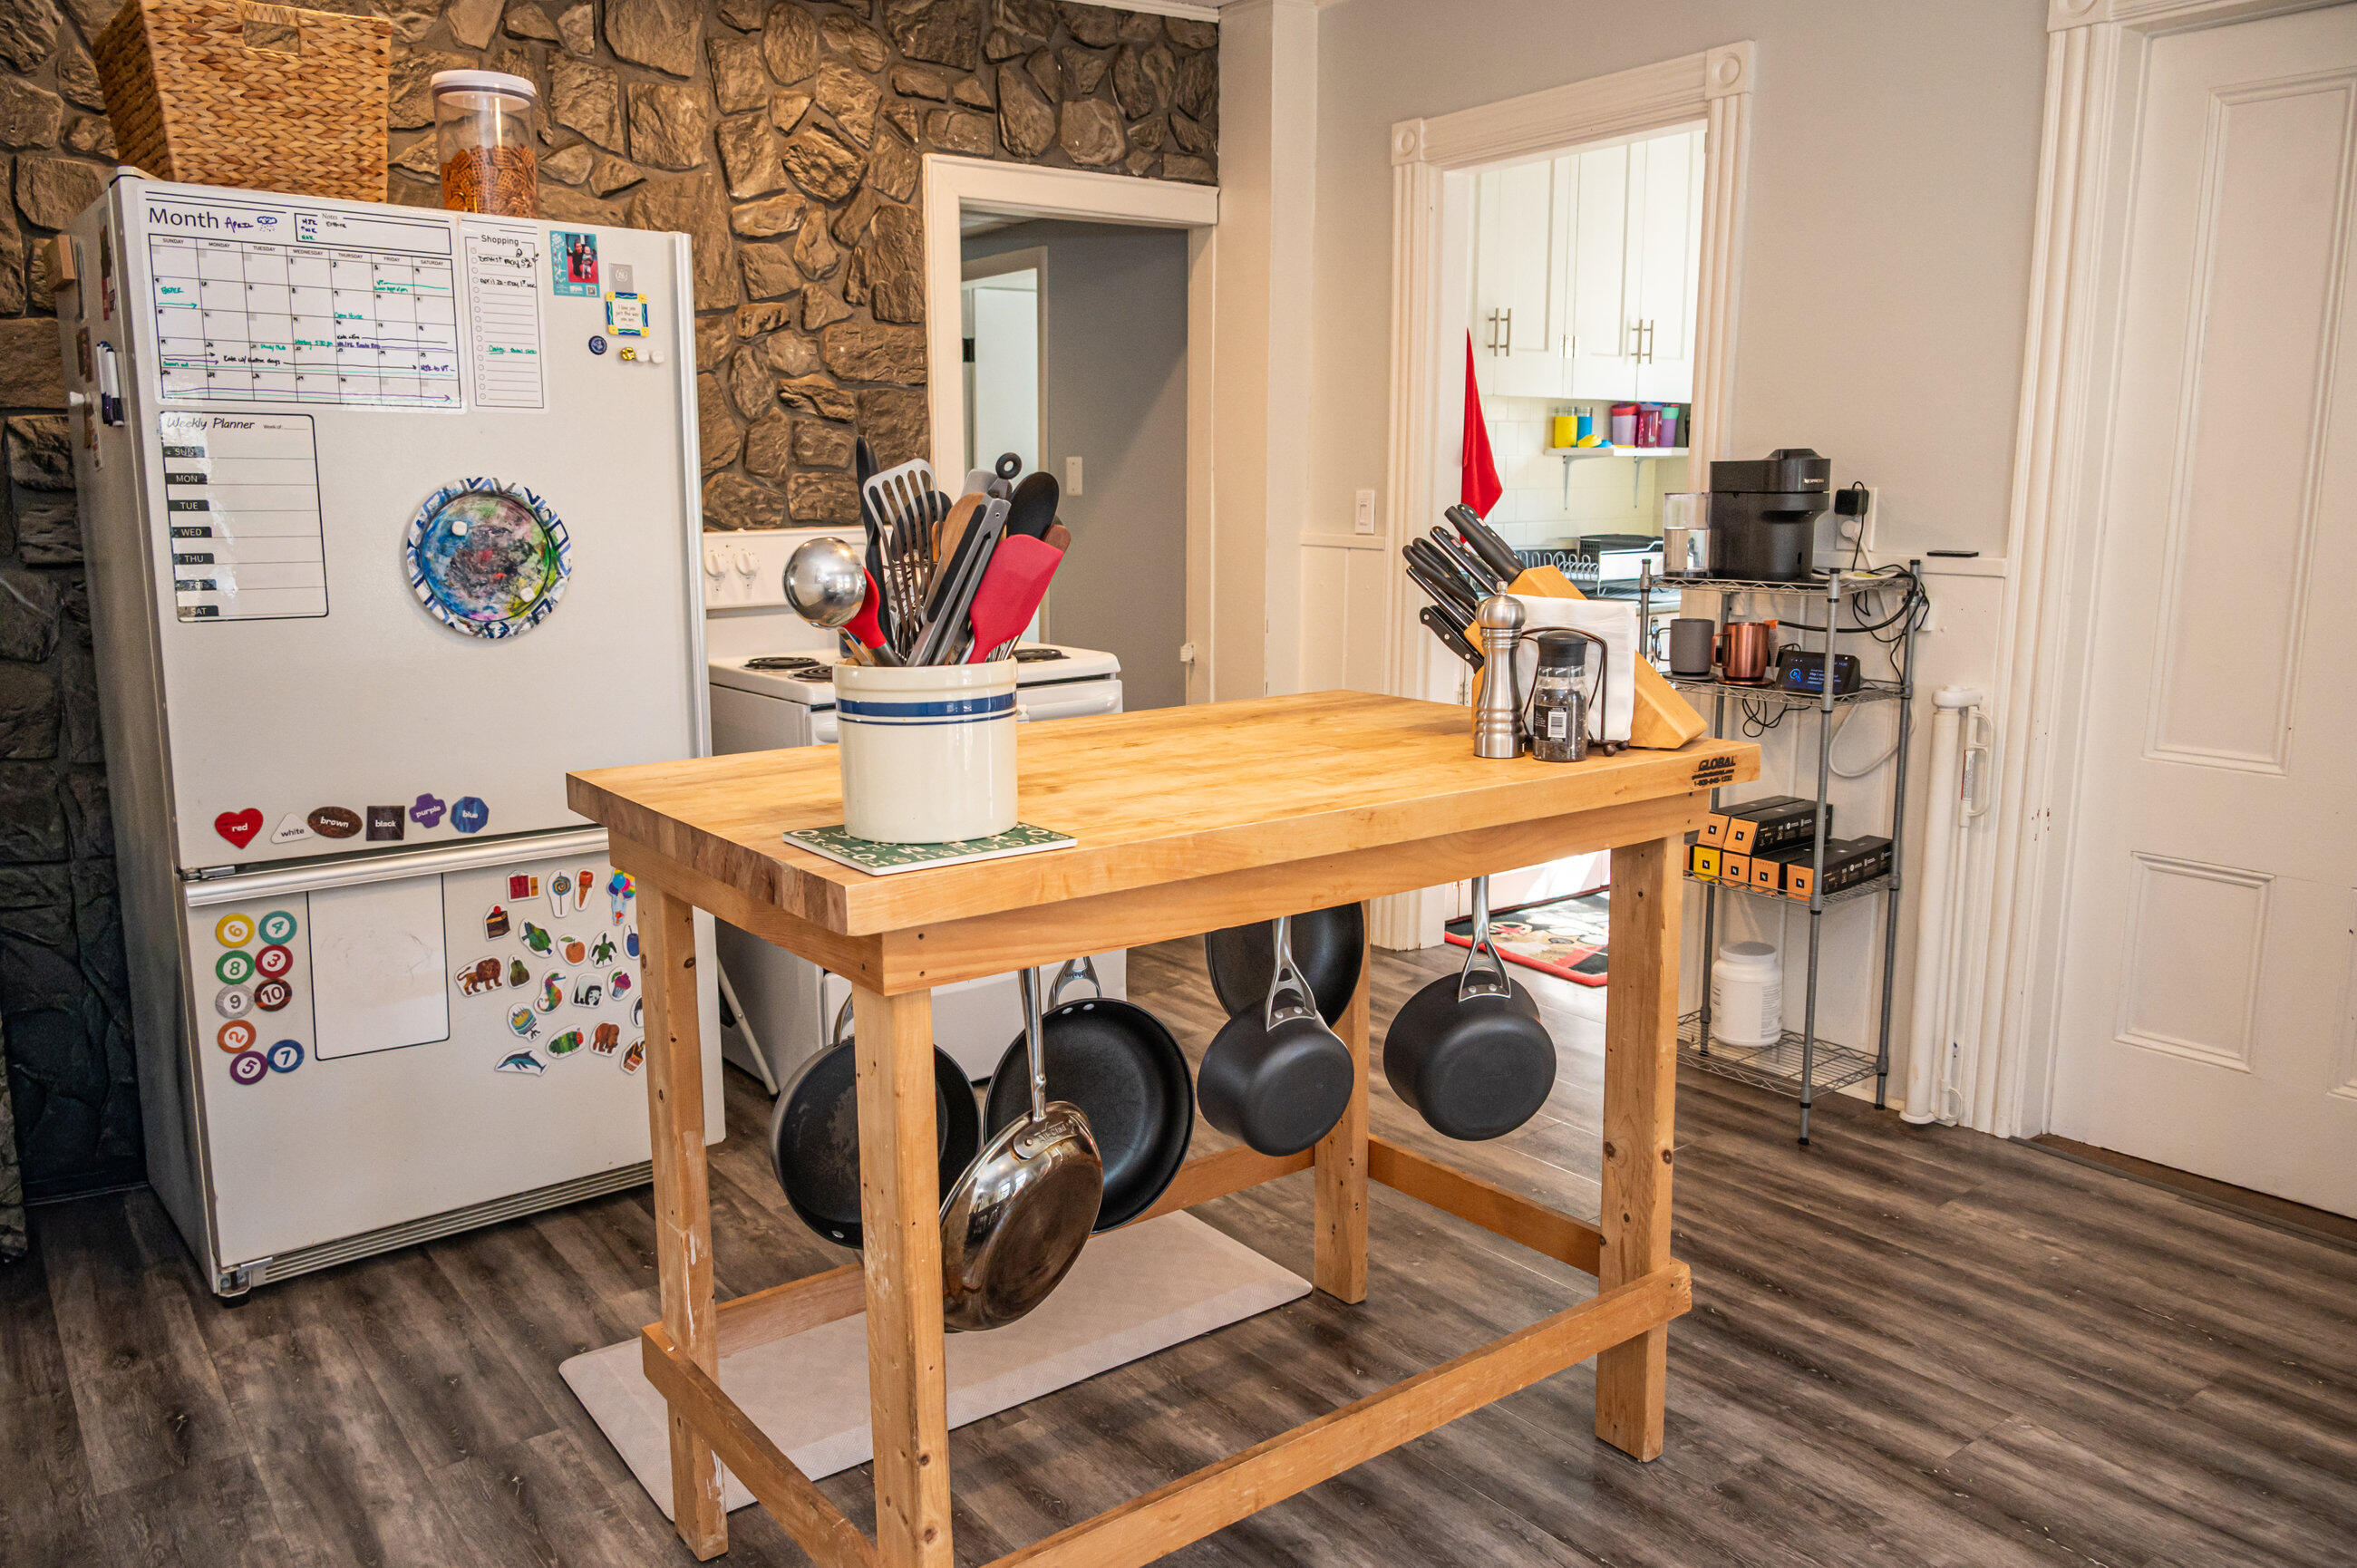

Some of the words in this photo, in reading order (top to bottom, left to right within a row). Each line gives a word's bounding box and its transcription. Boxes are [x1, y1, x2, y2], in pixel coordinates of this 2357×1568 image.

[149, 208, 219, 228] Month
[481, 235, 519, 247] Shopping
[167, 417, 207, 430] Weekly
[212, 418, 256, 430] Planner
[174, 448, 195, 456] SUN
[176, 475, 198, 483] MON
[179, 501, 199, 510] TUE
[181, 528, 202, 537] WED
[184, 555, 204, 563] THU
[190, 607, 207, 615] SAT
[1698, 756, 1736, 771] GLOBAL
[415, 804, 441, 819] purple
[462, 809, 479, 819] blue
[231, 822, 248, 833] red
[319, 816, 350, 829] brown
[374, 818, 397, 828] black
[280, 827, 306, 838] white
[228, 924, 243, 938] 6
[271, 920, 285, 934] 4
[267, 953, 281, 968] 3
[229, 961, 241, 976] 8
[262, 986, 284, 1003] 10
[229, 994, 242, 1010] 9
[228, 1031, 246, 1043] 2
[280, 1050, 292, 1066] 7
[242, 1060, 257, 1075] 5
[1038, 1124, 1067, 1141] All-Clad
